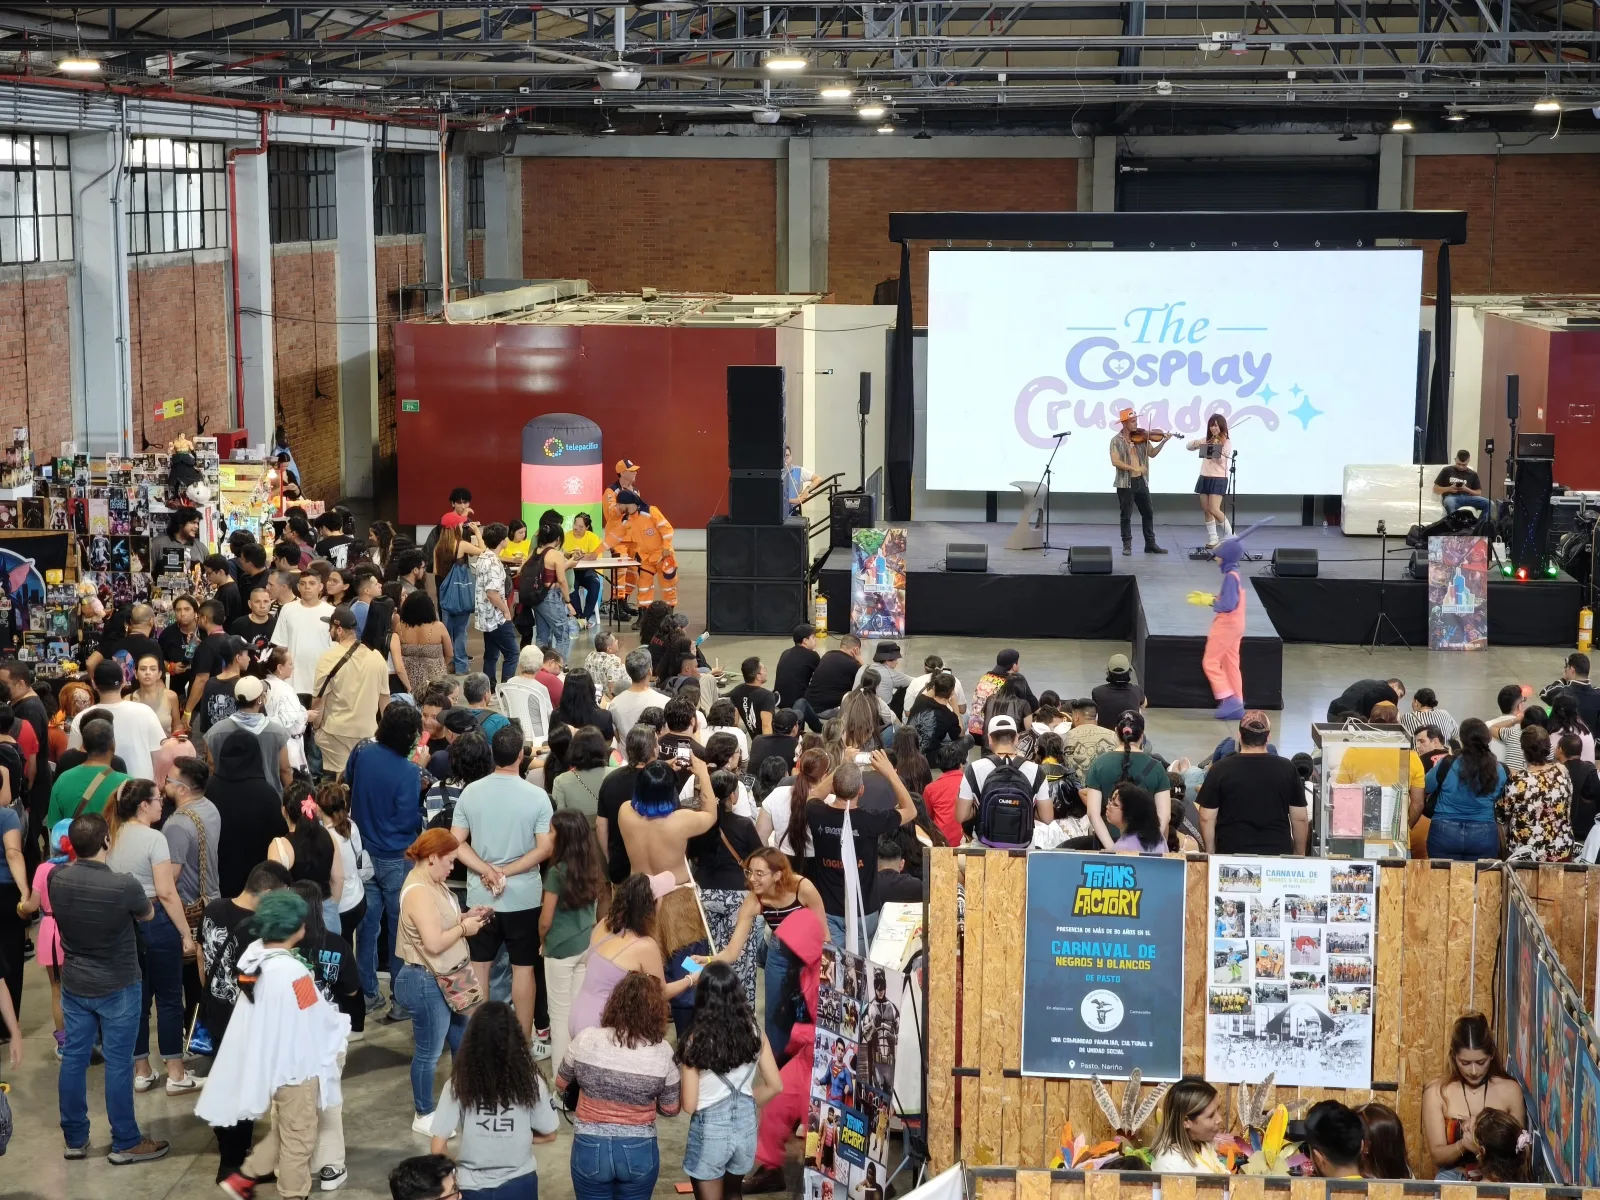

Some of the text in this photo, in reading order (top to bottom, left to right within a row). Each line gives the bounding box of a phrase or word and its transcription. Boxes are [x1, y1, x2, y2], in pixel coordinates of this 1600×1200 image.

[1124, 301, 1210, 344] The
[1266, 870, 1306, 878] CARNAVAL
[1074, 888, 1141, 916] FACTORY
[1052, 940, 1156, 959] CARNAVAL DE
[1056, 956, 1092, 967] NEGROS
[1106, 958, 1151, 970] BLANCOS
[1086, 974, 1121, 983] DE PASTO
[1102, 1063, 1123, 1071] Nariño
